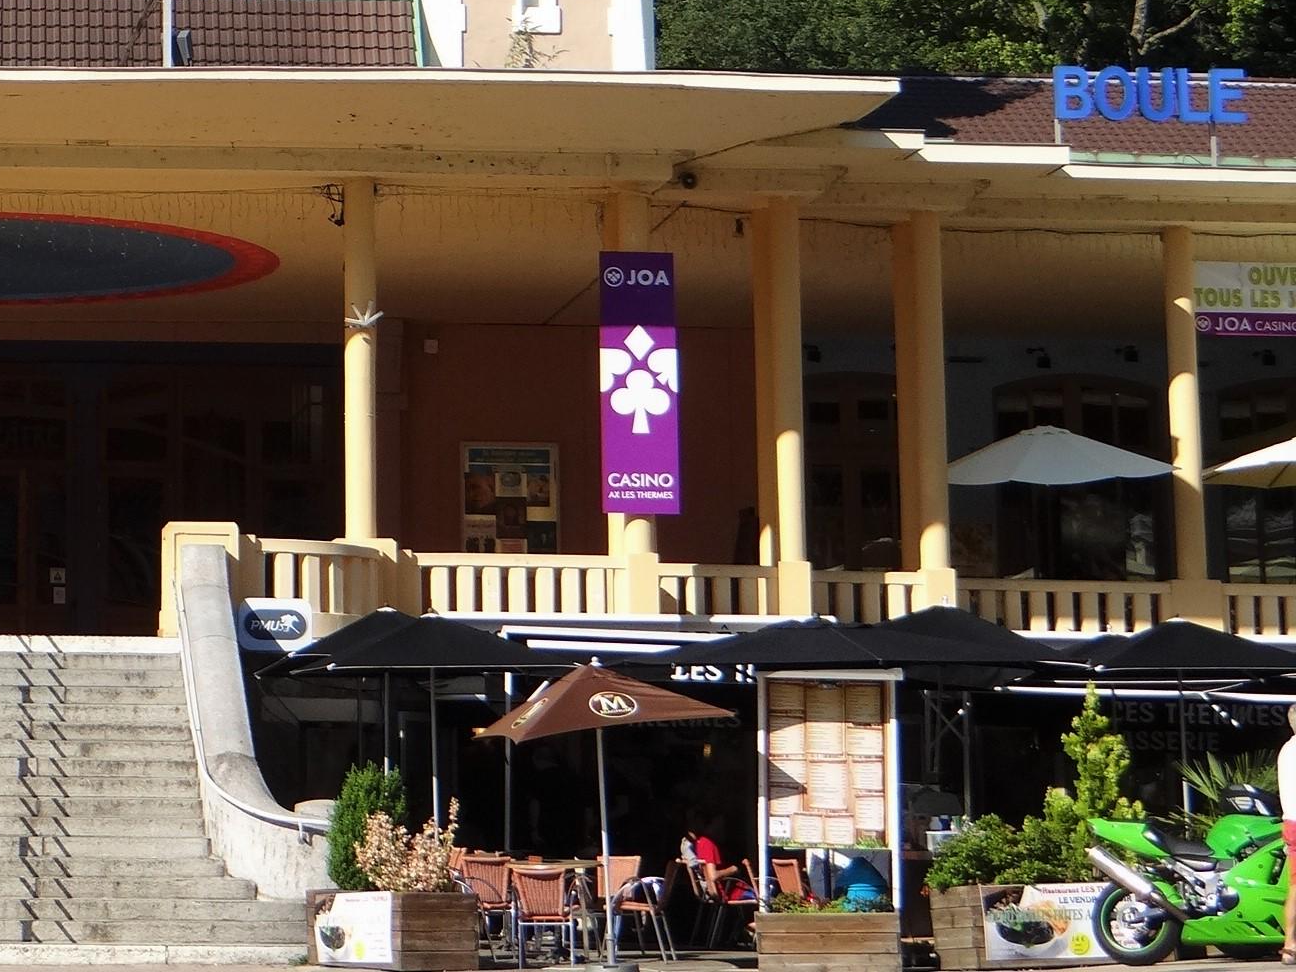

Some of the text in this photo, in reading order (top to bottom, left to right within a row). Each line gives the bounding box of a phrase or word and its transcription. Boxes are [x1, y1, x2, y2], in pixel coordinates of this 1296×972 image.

[1053, 64, 1249, 124] BOULE
[627, 269, 670, 287] JOA
[1194, 287, 1243, 308] TOUS
[1250, 289, 1281, 309] LES
[1215, 317, 1252, 332] JOA
[607, 472, 674, 488] CASINO
[608, 490, 674, 499] AX LES THERMES
[250, 619, 280, 632] PMU
[1058, 896, 1070, 904] LE
